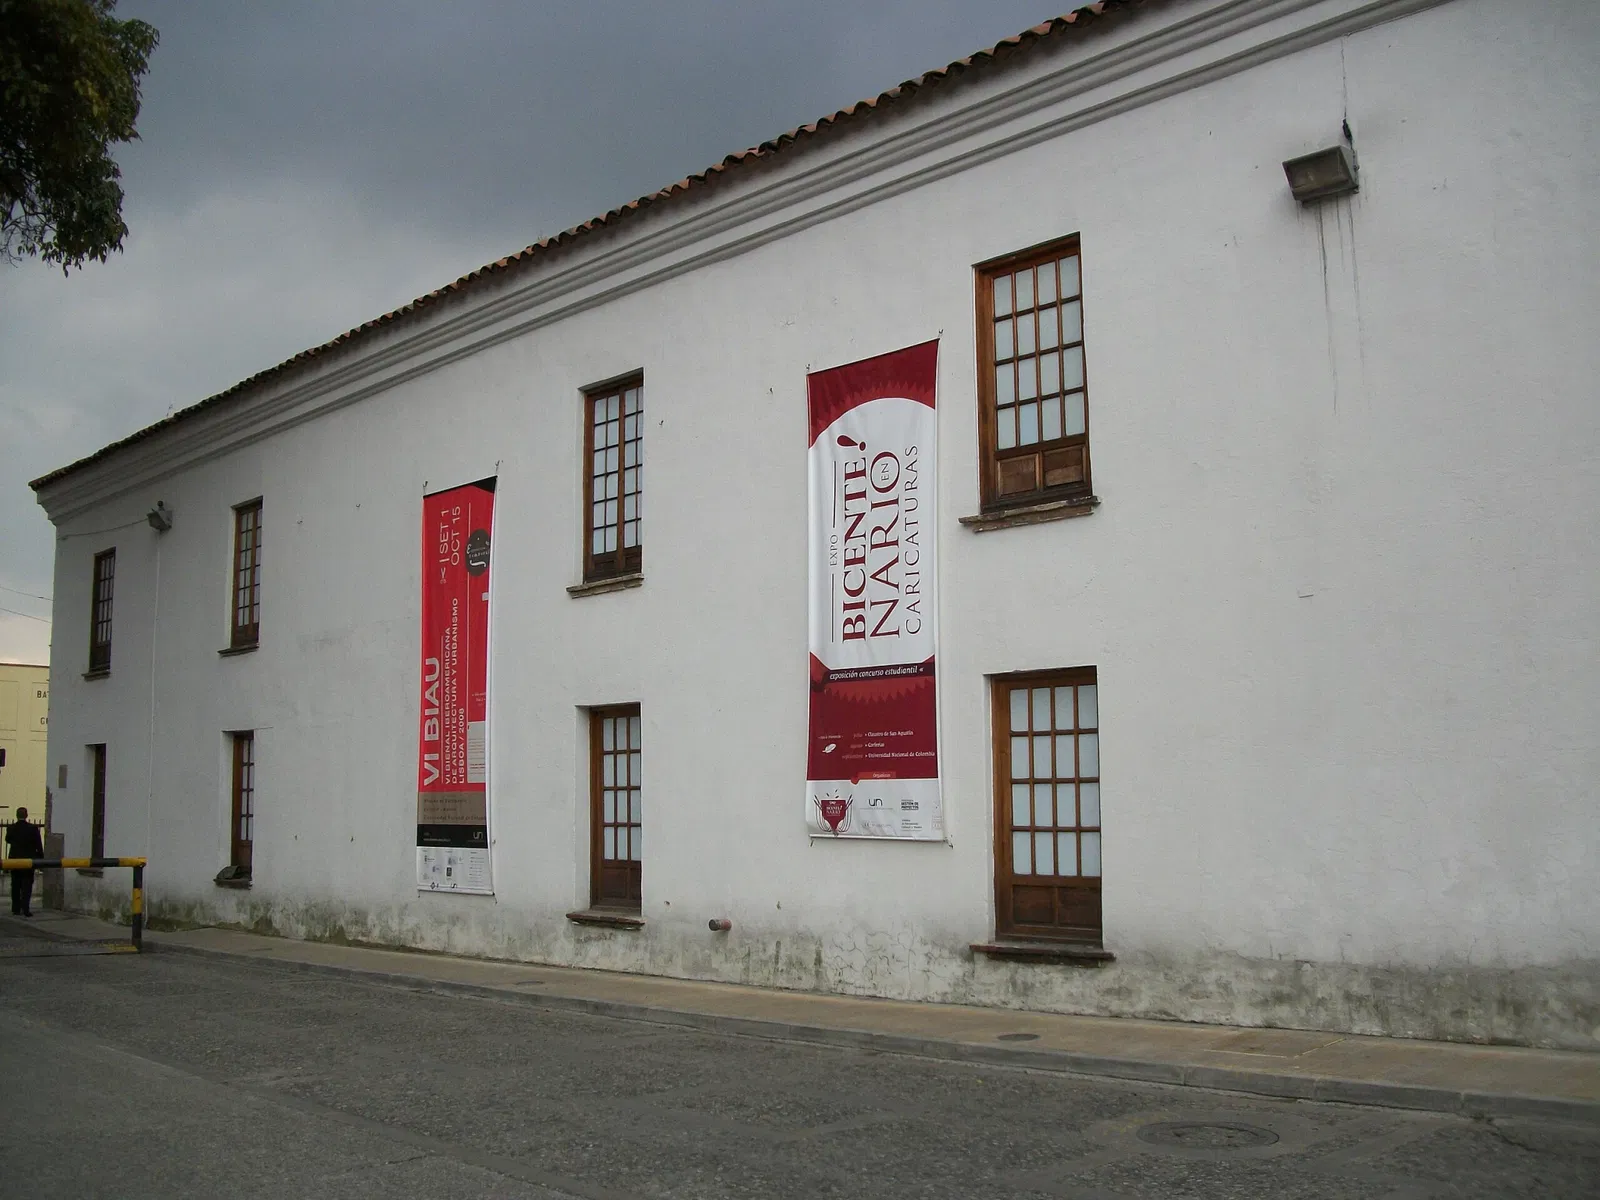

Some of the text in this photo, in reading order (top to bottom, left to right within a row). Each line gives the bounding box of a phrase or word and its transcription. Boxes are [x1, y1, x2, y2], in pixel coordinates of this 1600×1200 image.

[880, 462, 889, 481] EN
[440, 507, 449, 554] SET 1
[451, 506, 460, 566] OCT 15
[829, 534, 839, 566] EXPO
[869, 451, 900, 638] NARIO
[904, 445, 921, 635] CARICATURAS
[451, 598, 459, 666] URBANISMO
[829, 665, 918, 681] exposición concurso estudiantil
[424, 657, 440, 786] VI BIAU
[444, 773, 451, 785] VI
[451, 767, 458, 784] DE
[868, 798, 883, 807] un
